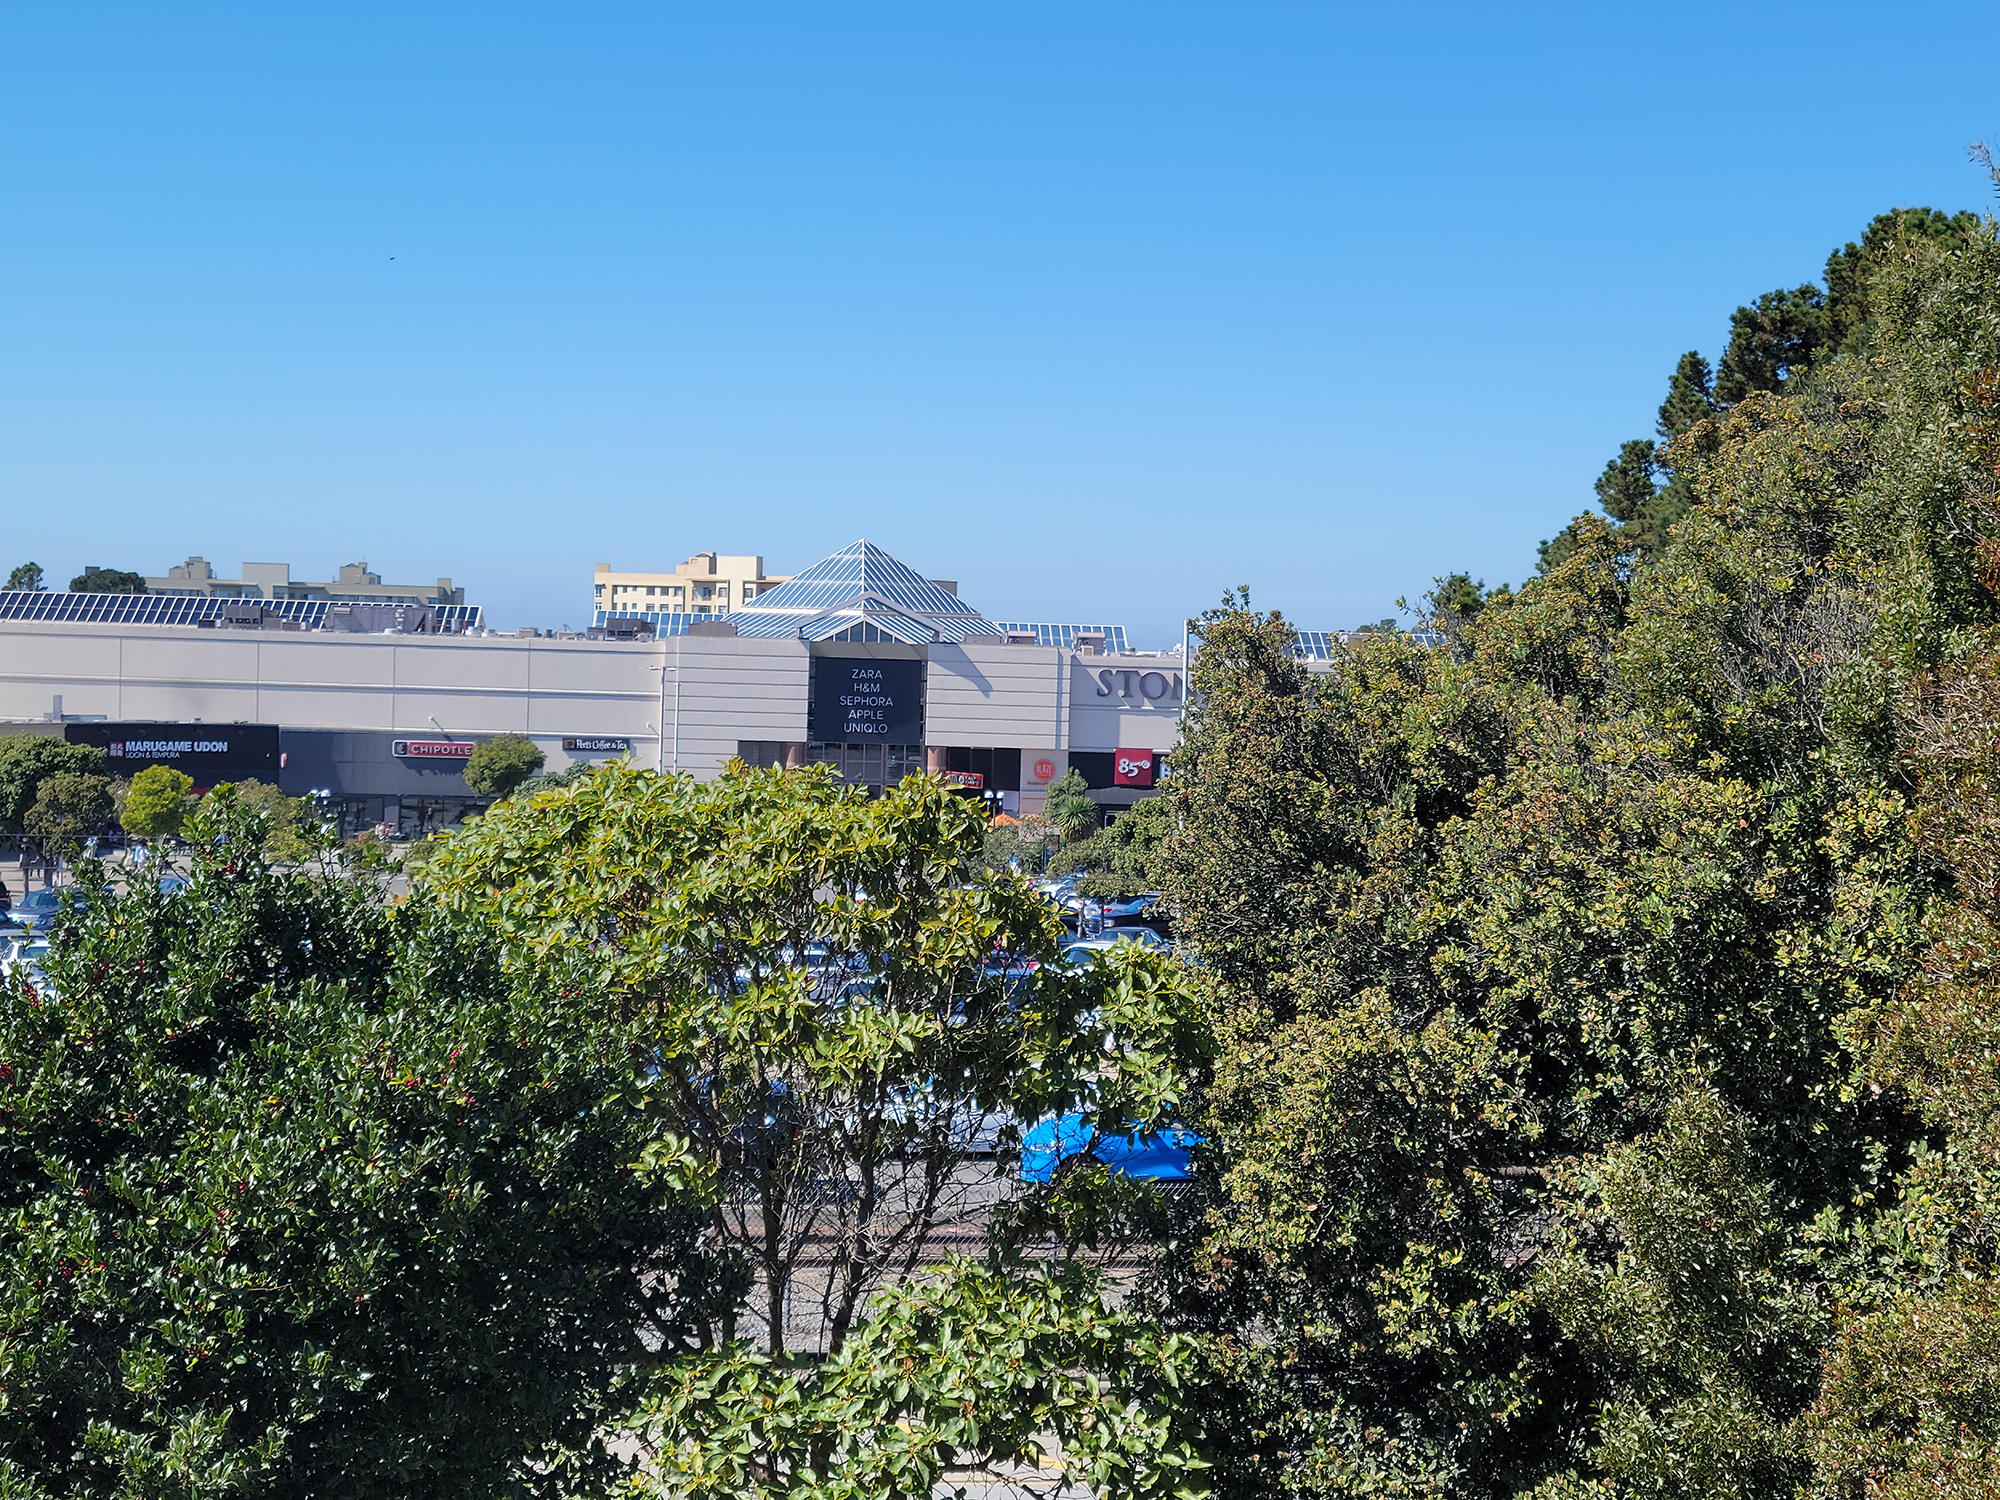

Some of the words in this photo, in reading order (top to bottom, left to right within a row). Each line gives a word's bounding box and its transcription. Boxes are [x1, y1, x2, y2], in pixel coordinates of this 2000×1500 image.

[851, 669, 883, 679] ZARA
[854, 683, 880, 693] H&M
[840, 696, 893, 707] SEPHORA
[848, 710, 884, 720] APPLE
[843, 723, 888, 733] UNIQLO
[125, 741, 192, 752] MARUGAME
[194, 742, 228, 752] UDON
[411, 745, 472, 755] CHIPOTLE
[592, 740, 611, 750] Coffee
